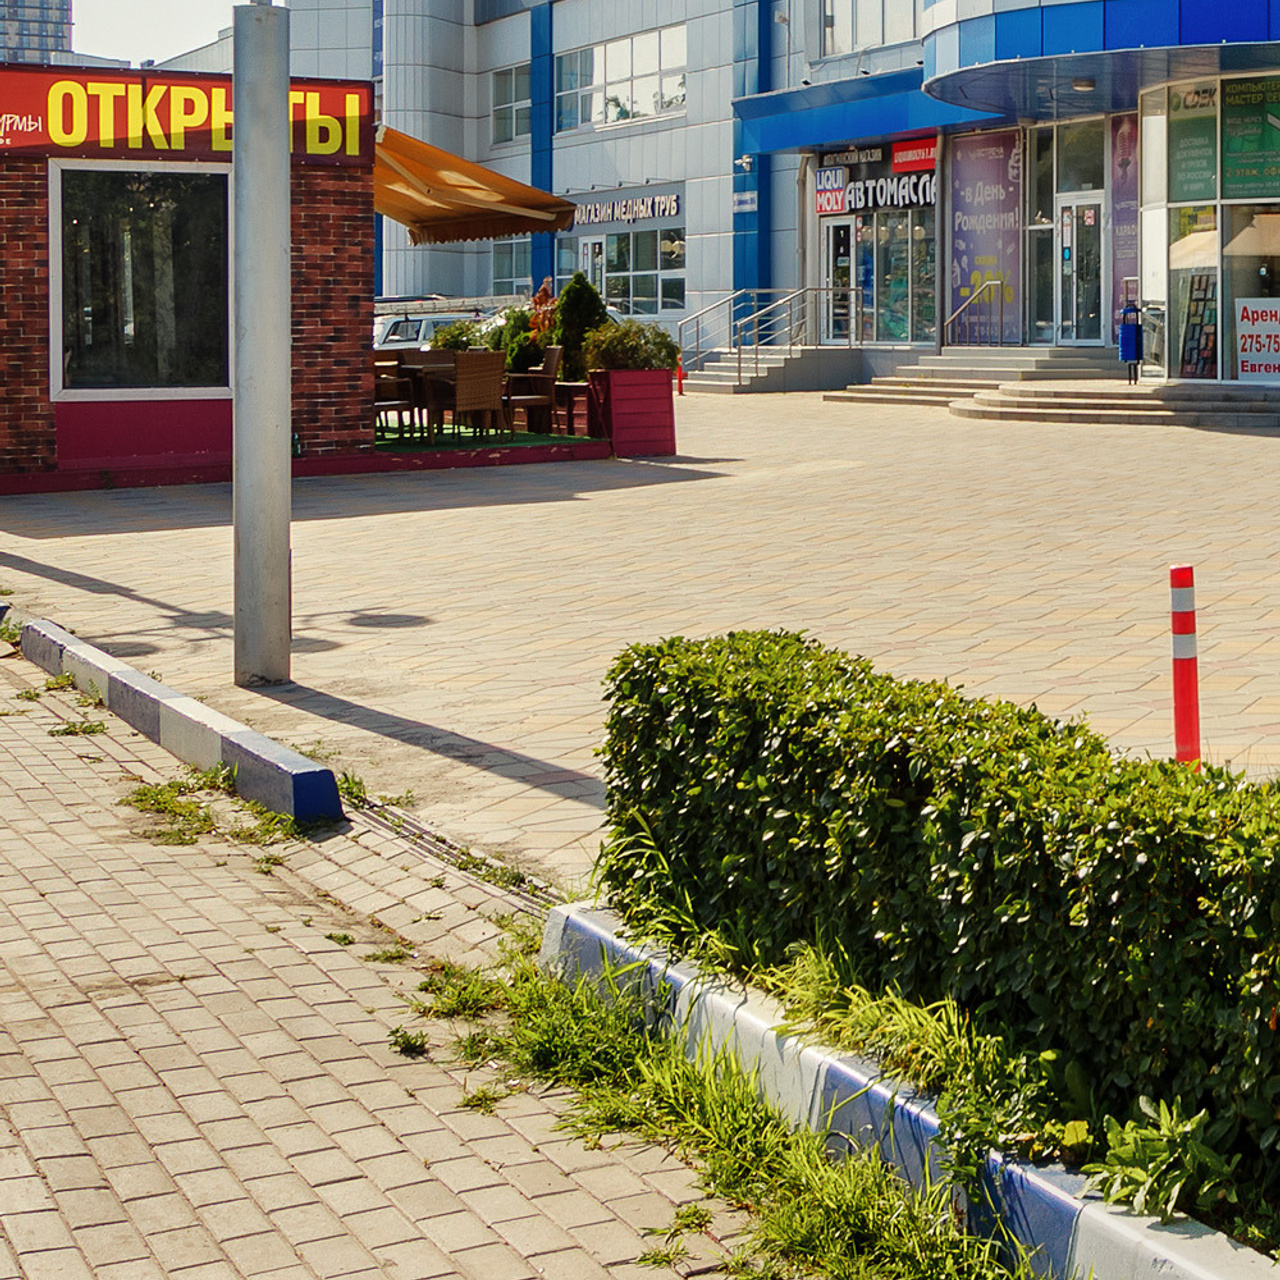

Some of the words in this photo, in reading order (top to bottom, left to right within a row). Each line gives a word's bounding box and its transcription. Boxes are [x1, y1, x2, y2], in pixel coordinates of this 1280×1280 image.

[1225, 94, 1264, 105] МАСТЕР
[47, 80, 359, 156] ОТКРЫ
[816, 168, 844, 190] LIQUI
[816, 190, 844, 211] MOLY
[974, 180, 1006, 206] День
[654, 194, 679, 217] ТРУБ
[955, 207, 1019, 235] Рождения!
